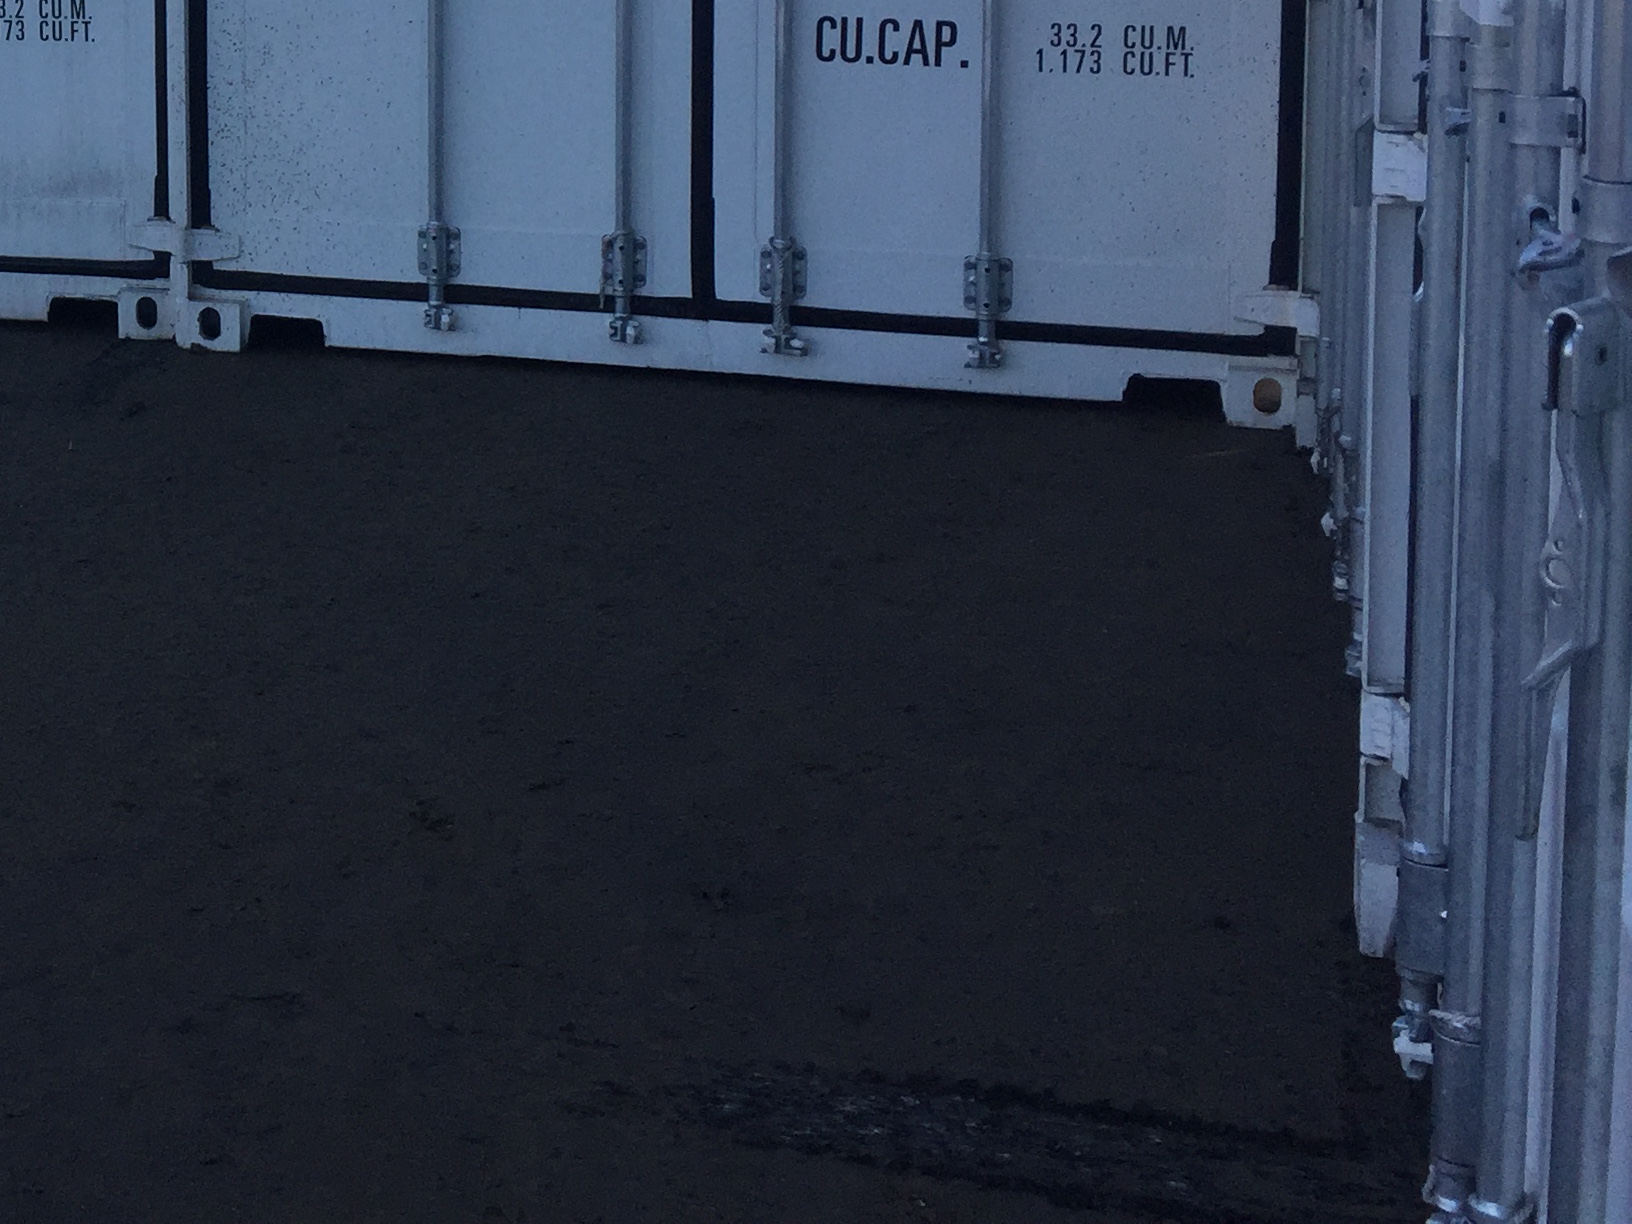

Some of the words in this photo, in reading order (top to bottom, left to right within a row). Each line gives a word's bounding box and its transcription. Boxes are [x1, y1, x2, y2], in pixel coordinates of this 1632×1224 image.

[39, 19, 95, 43] CU.FT.
[815, 15, 969, 69] CU.CAP.
[1049, 22, 1103, 49] 33.2
[1123, 24, 1194, 51] CU.M.
[1036, 48, 1102, 75] 1.173
[1122, 47, 1195, 79] CU.FT.
